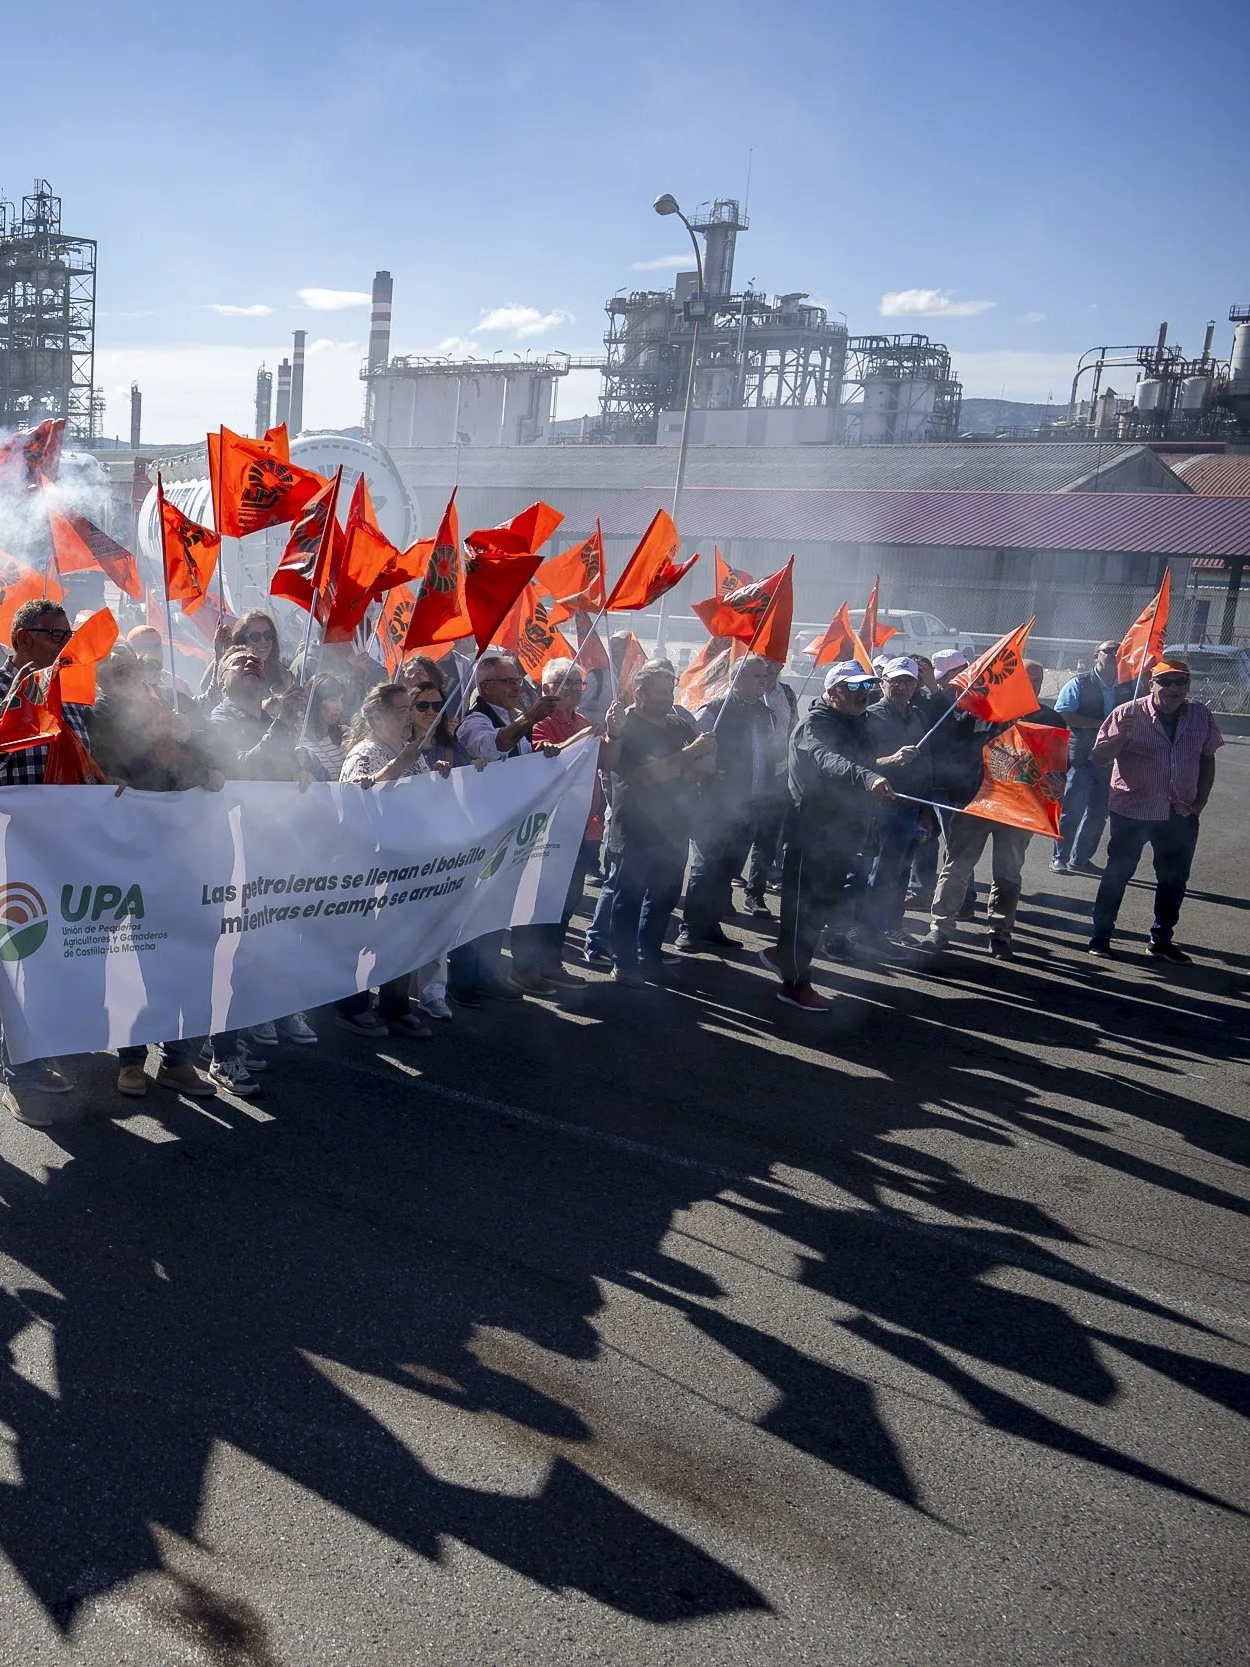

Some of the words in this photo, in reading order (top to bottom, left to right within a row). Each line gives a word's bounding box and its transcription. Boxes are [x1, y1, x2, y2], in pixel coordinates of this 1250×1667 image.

[201, 884, 237, 905] Las
[241, 873, 339, 907] petroleras
[340, 873, 363, 890] se
[365, 864, 420, 887] llenan
[421, 857, 438, 876] el
[435, 847, 487, 874] bolsillo
[60, 883, 145, 922] UPA
[220, 905, 301, 934] mientras
[303, 899, 325, 917] el
[323, 894, 389, 917] campo
[389, 890, 408, 907] se
[408, 876, 466, 902] arruina
[62, 925, 83, 936] Unión
[84, 925, 97, 934] de
[98, 923, 142, 935] Pequeños
[63, 935, 111, 948] Agricultores
[112, 936, 119, 944] y
[119, 931, 168, 942] Ganaderos
[63, 949, 74, 958] de
[75, 945, 120, 957] Castilla-La
[121, 942, 156, 953] Mancha
